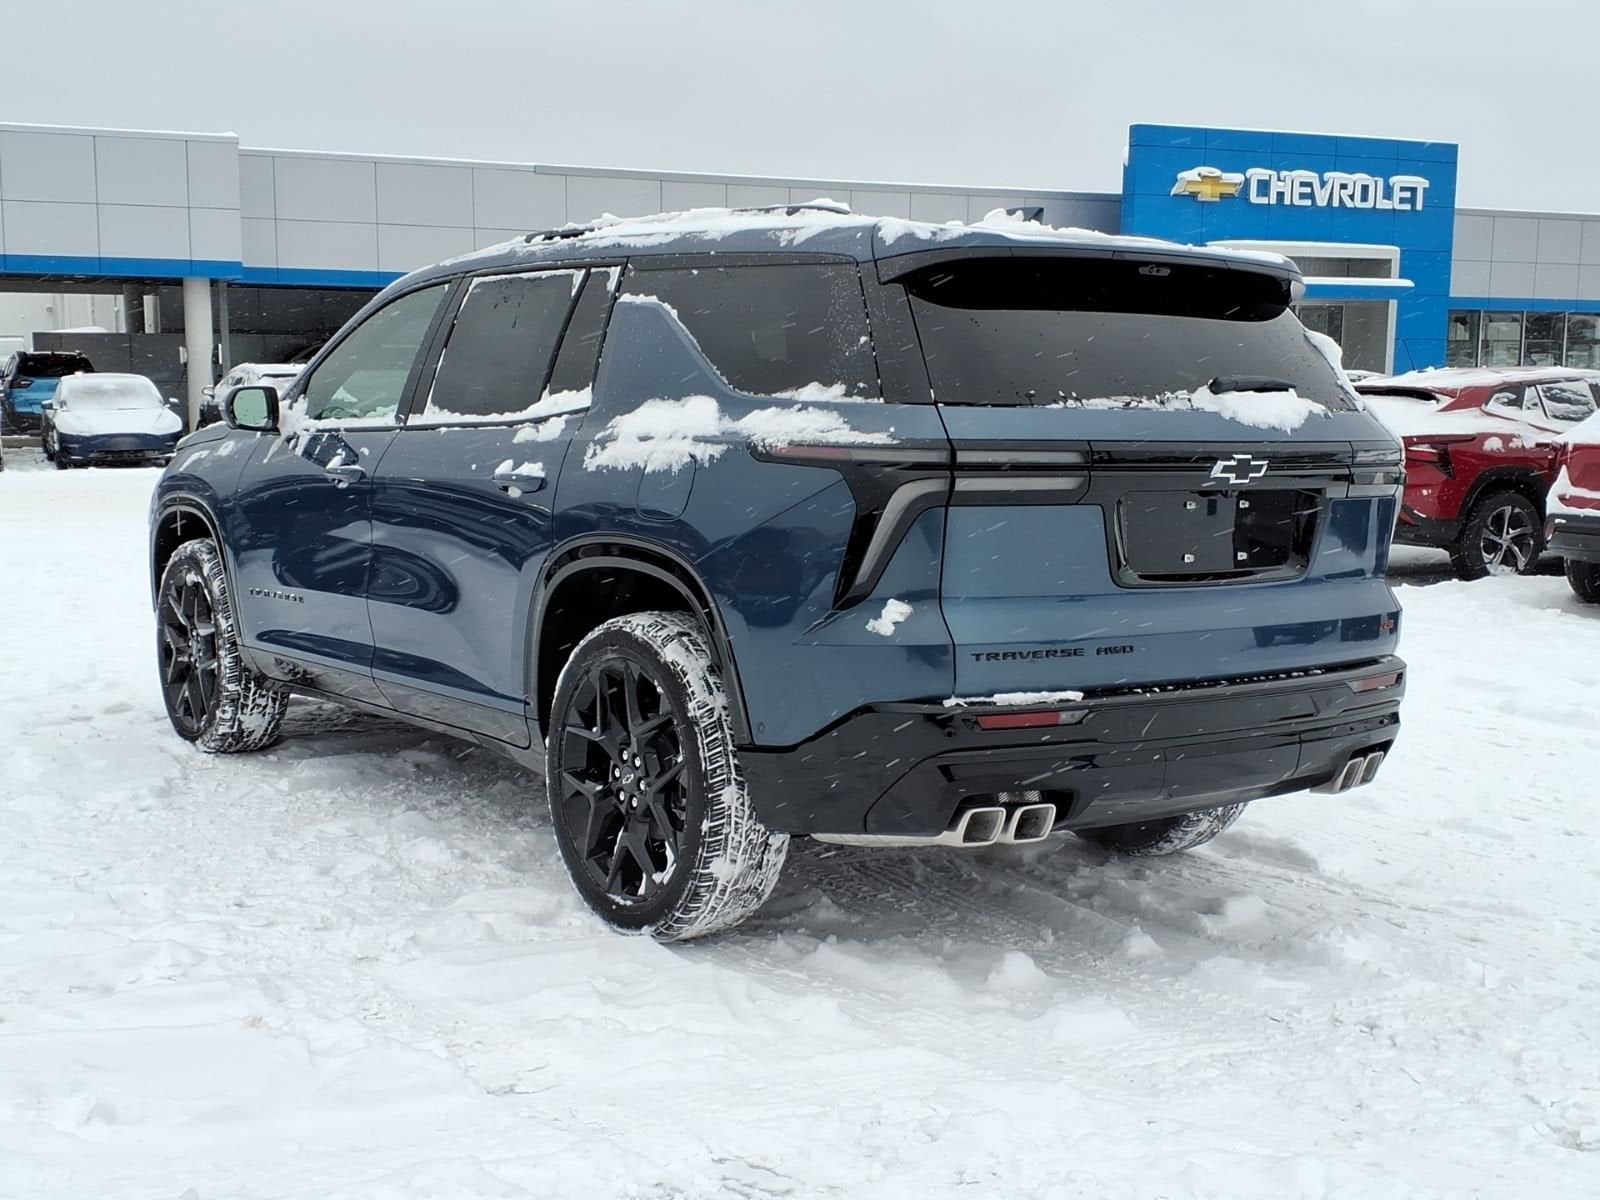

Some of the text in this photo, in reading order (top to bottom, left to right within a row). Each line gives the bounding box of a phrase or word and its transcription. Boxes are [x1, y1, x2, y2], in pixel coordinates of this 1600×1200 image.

[1247, 169, 1429, 211] CHEVROLET
[971, 645, 1134, 662] TRAVERSE AWD
